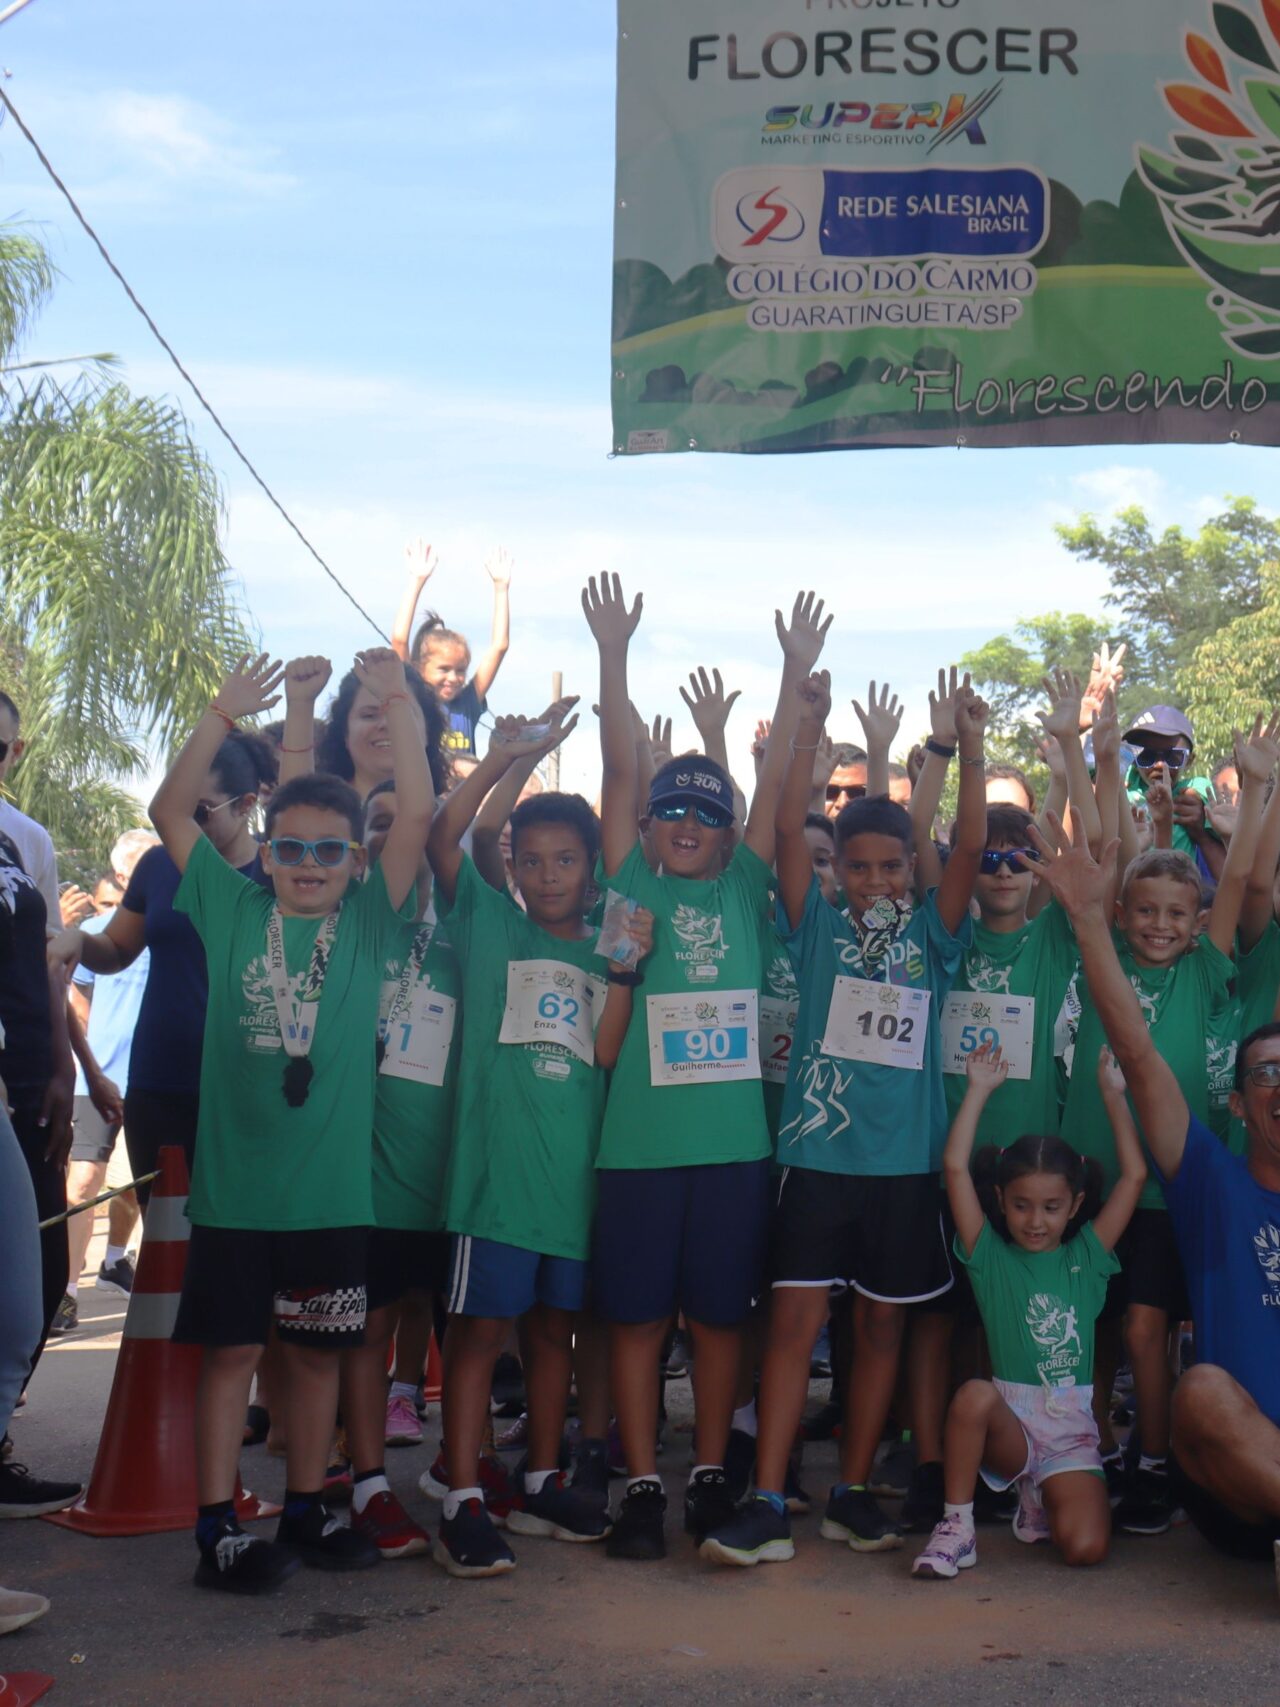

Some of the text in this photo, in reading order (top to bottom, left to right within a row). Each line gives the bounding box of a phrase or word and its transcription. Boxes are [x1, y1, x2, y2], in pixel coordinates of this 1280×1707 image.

[688, 27, 1079, 80] FLORESCER
[761, 133, 925, 146] MARKETING ESPORTIVO
[838, 194, 1030, 217] REDE SALESIANA
[968, 217, 1030, 233] BRASIL
[733, 264, 1033, 294] COLÉGIO DO CARMO
[268, 918, 283, 969] FLORESCER
[538, 992, 580, 1027] 62
[534, 1020, 557, 1029] Enzo
[857, 1010, 914, 1043] 102
[685, 1029, 730, 1060] 90
[960, 1025, 1000, 1053] 59
[672, 1061, 721, 1072] Guilherme
[298, 1300, 339, 1315] SCALE
